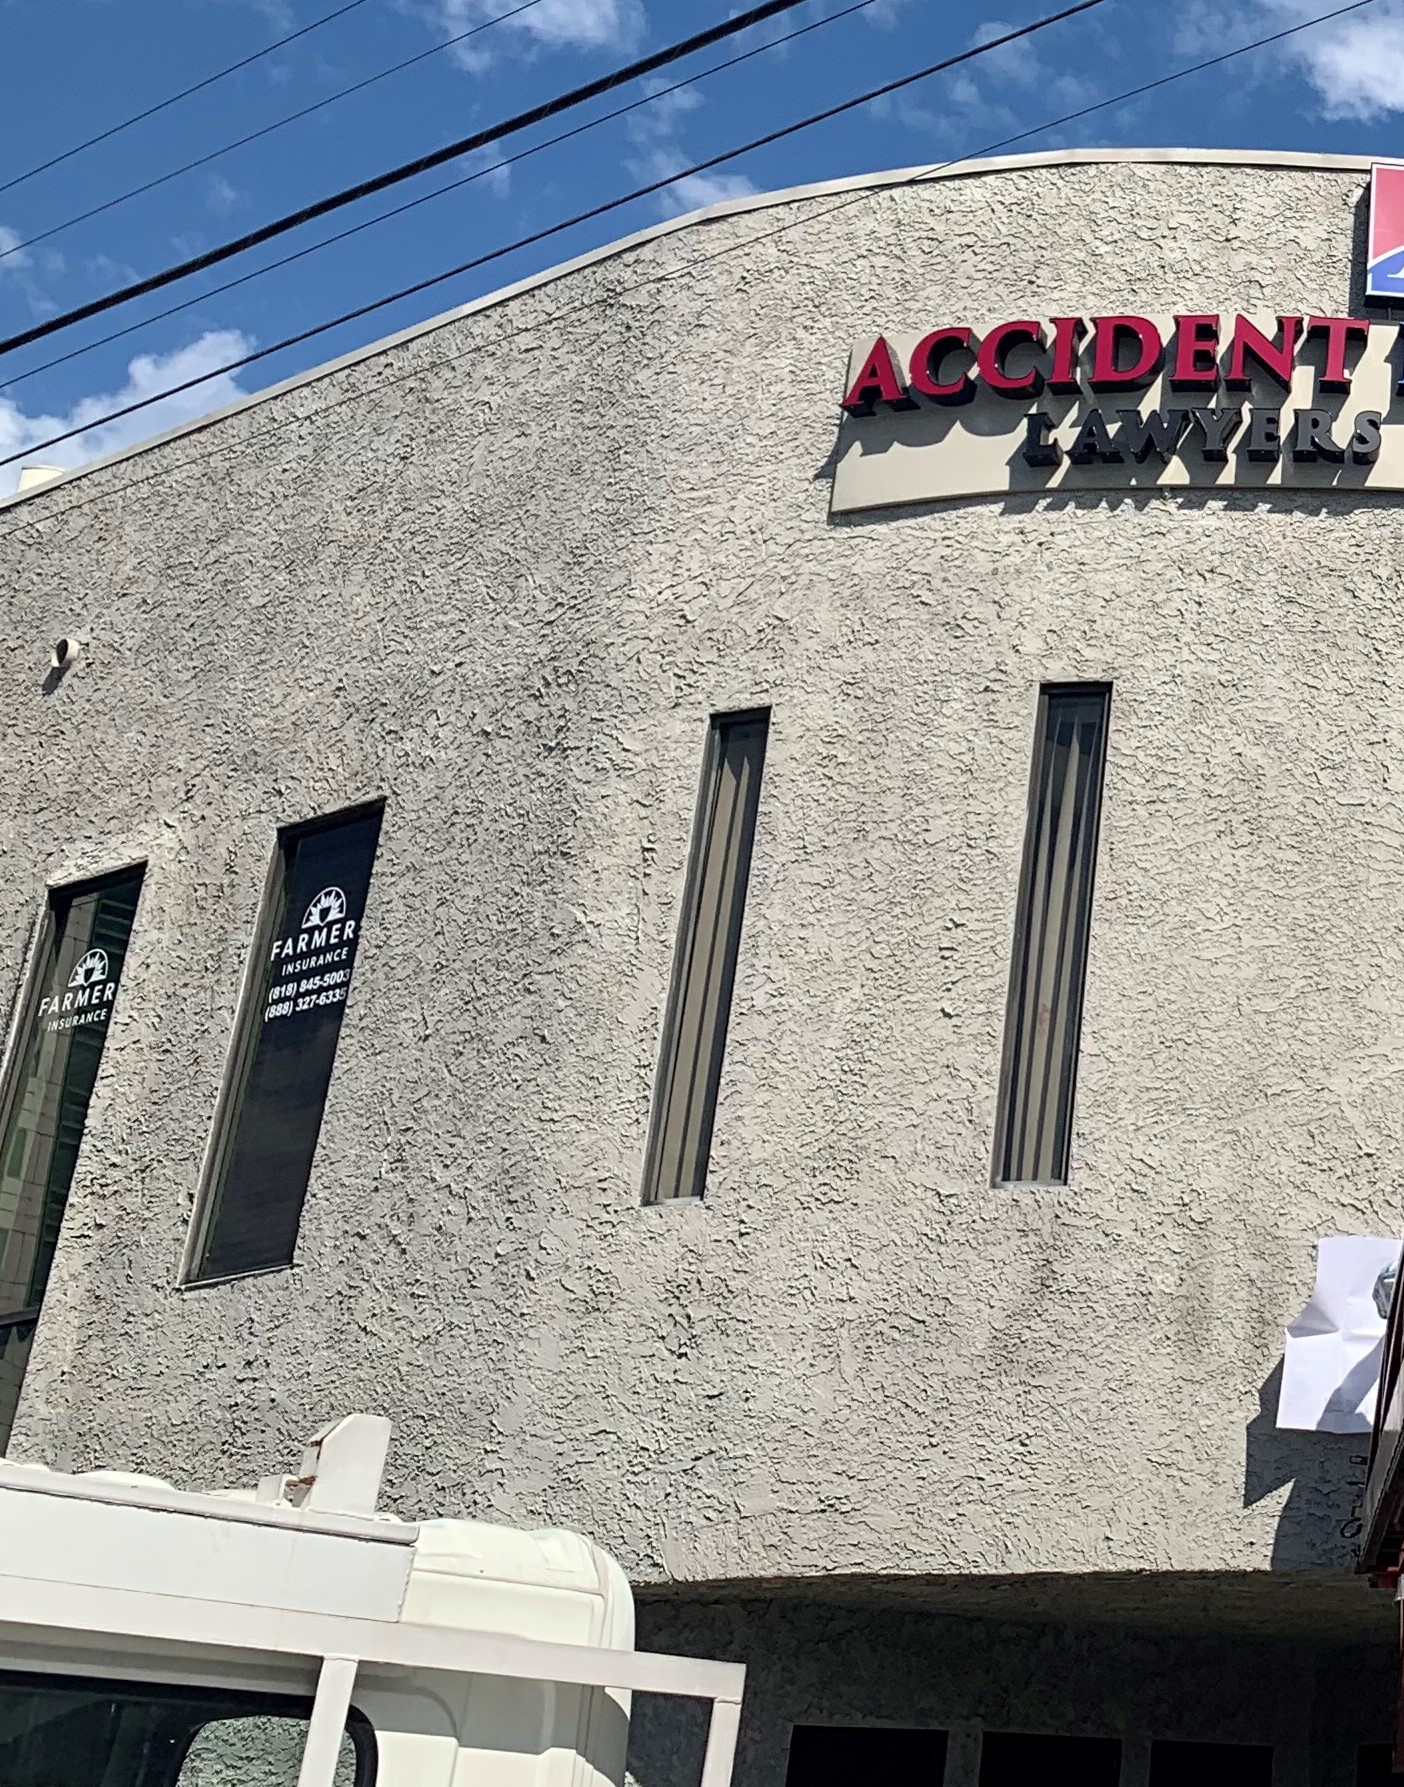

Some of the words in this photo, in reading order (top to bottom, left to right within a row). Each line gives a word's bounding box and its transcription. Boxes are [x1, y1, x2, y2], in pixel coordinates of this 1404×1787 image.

[841, 314, 1371, 417] ACCIDENT
[1022, 408, 1383, 466] LAWYERS
[281, 947, 349, 976] INSURANCE
[269, 981, 298, 1003] (818)
[299, 968, 351, 993] 845-5003
[46, 1008, 108, 1032] INSURANCE
[265, 1000, 294, 1022] (888)
[295, 987, 348, 1012] 327-6335
